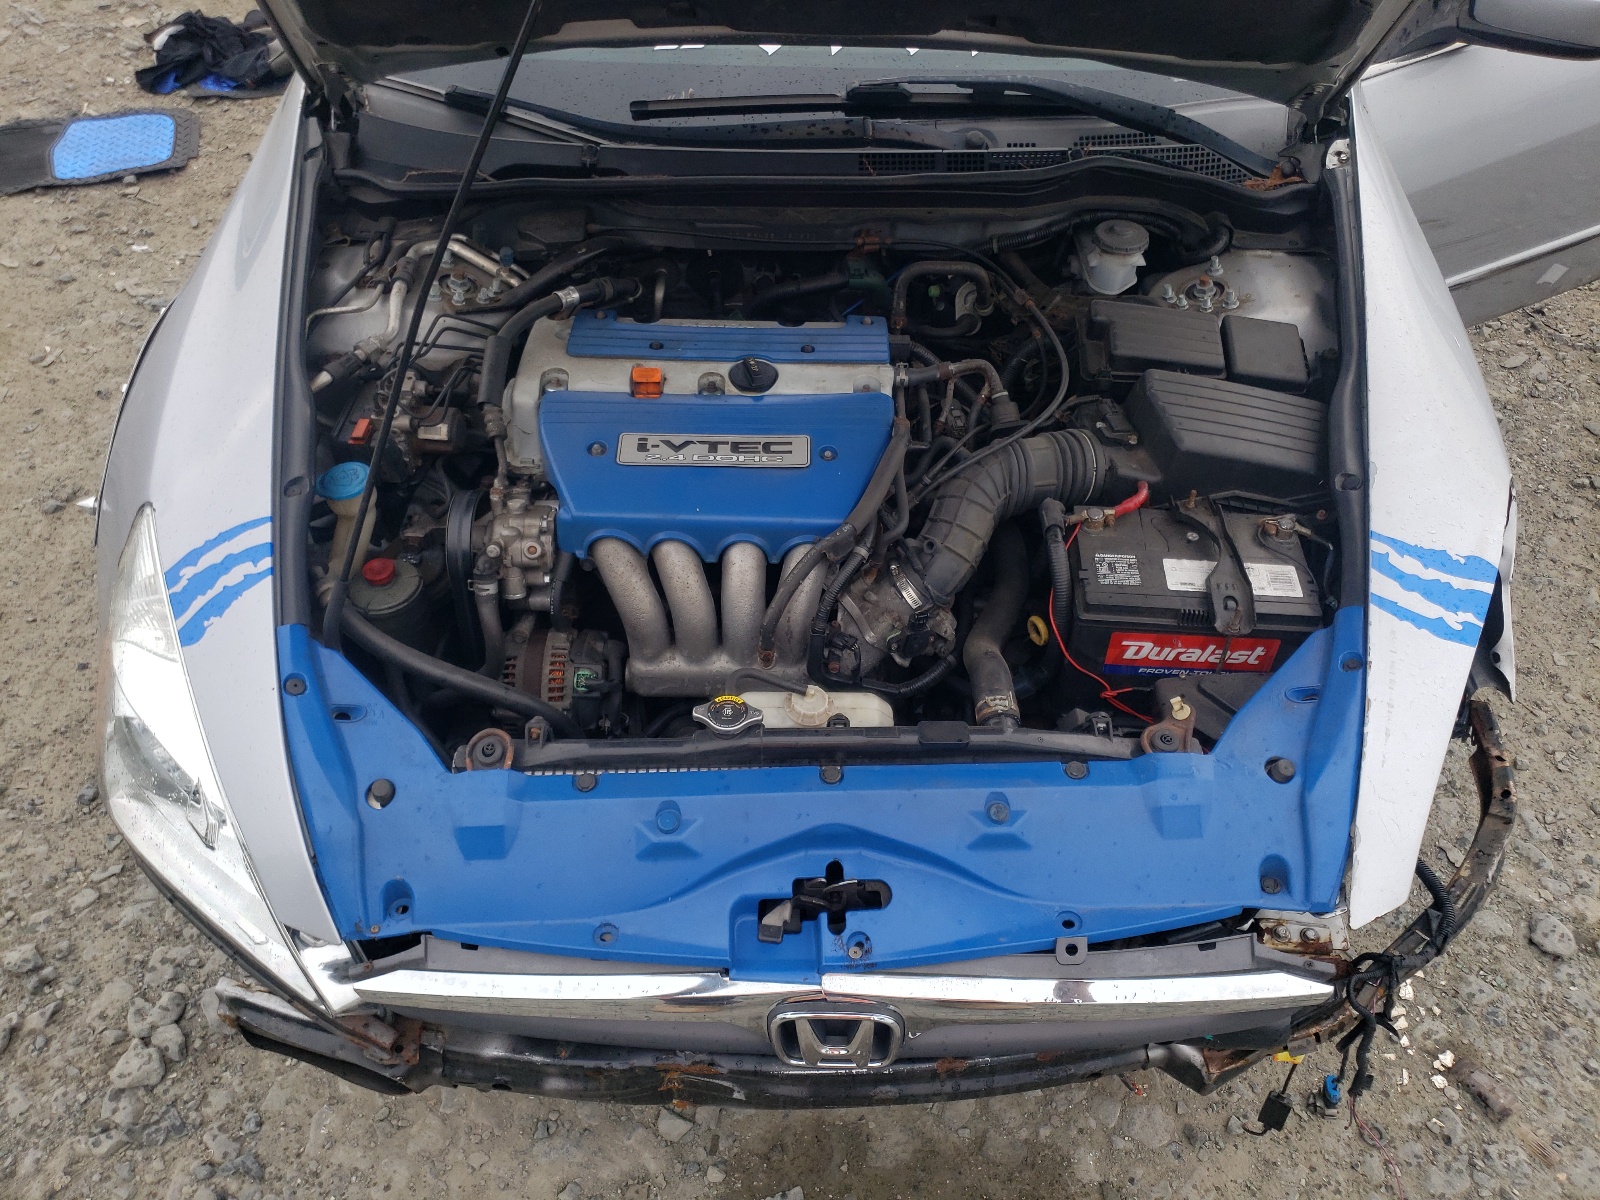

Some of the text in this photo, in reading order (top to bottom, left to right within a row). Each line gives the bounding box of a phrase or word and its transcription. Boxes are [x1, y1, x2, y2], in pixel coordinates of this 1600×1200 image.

[636, 437, 793, 455] i-VTEC
[645, 453, 783, 463] 2.4 DOHC
[1121, 640, 1266, 665] Duralast
